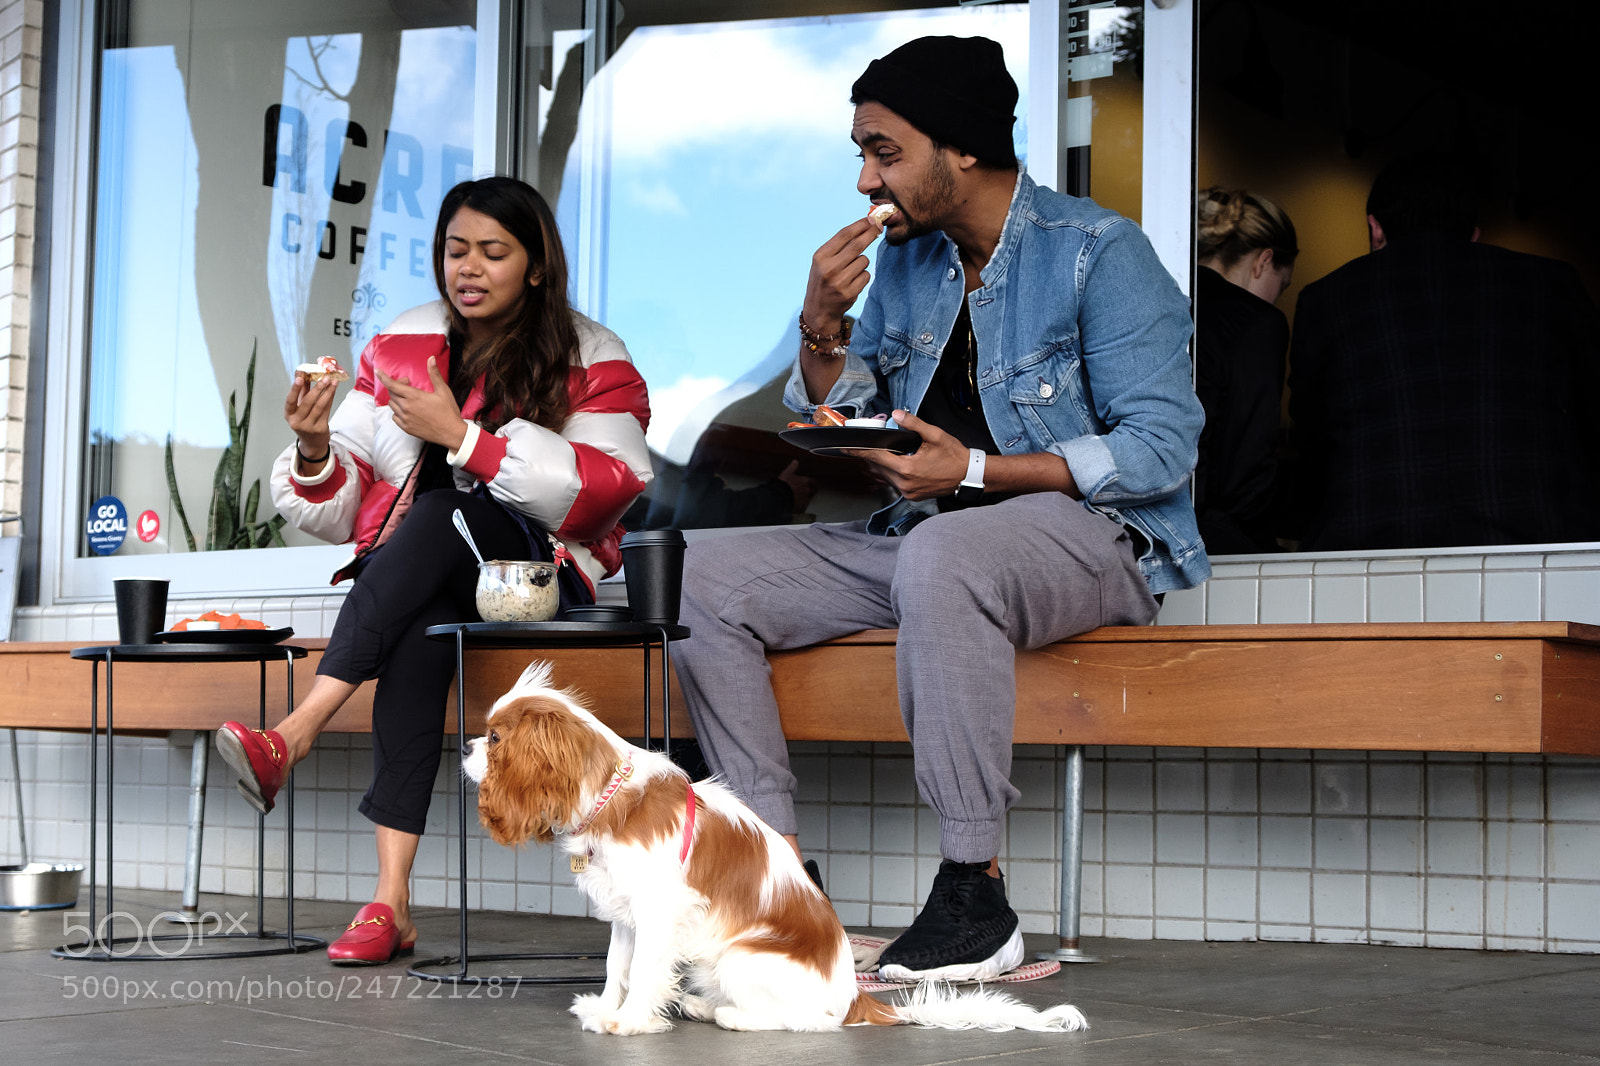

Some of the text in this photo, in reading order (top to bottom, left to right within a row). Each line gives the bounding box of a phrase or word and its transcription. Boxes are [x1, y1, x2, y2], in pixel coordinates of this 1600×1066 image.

[334, 318, 365, 339] EST.
[98, 505, 117, 519] GO
[87, 519, 127, 533] LOCAL
